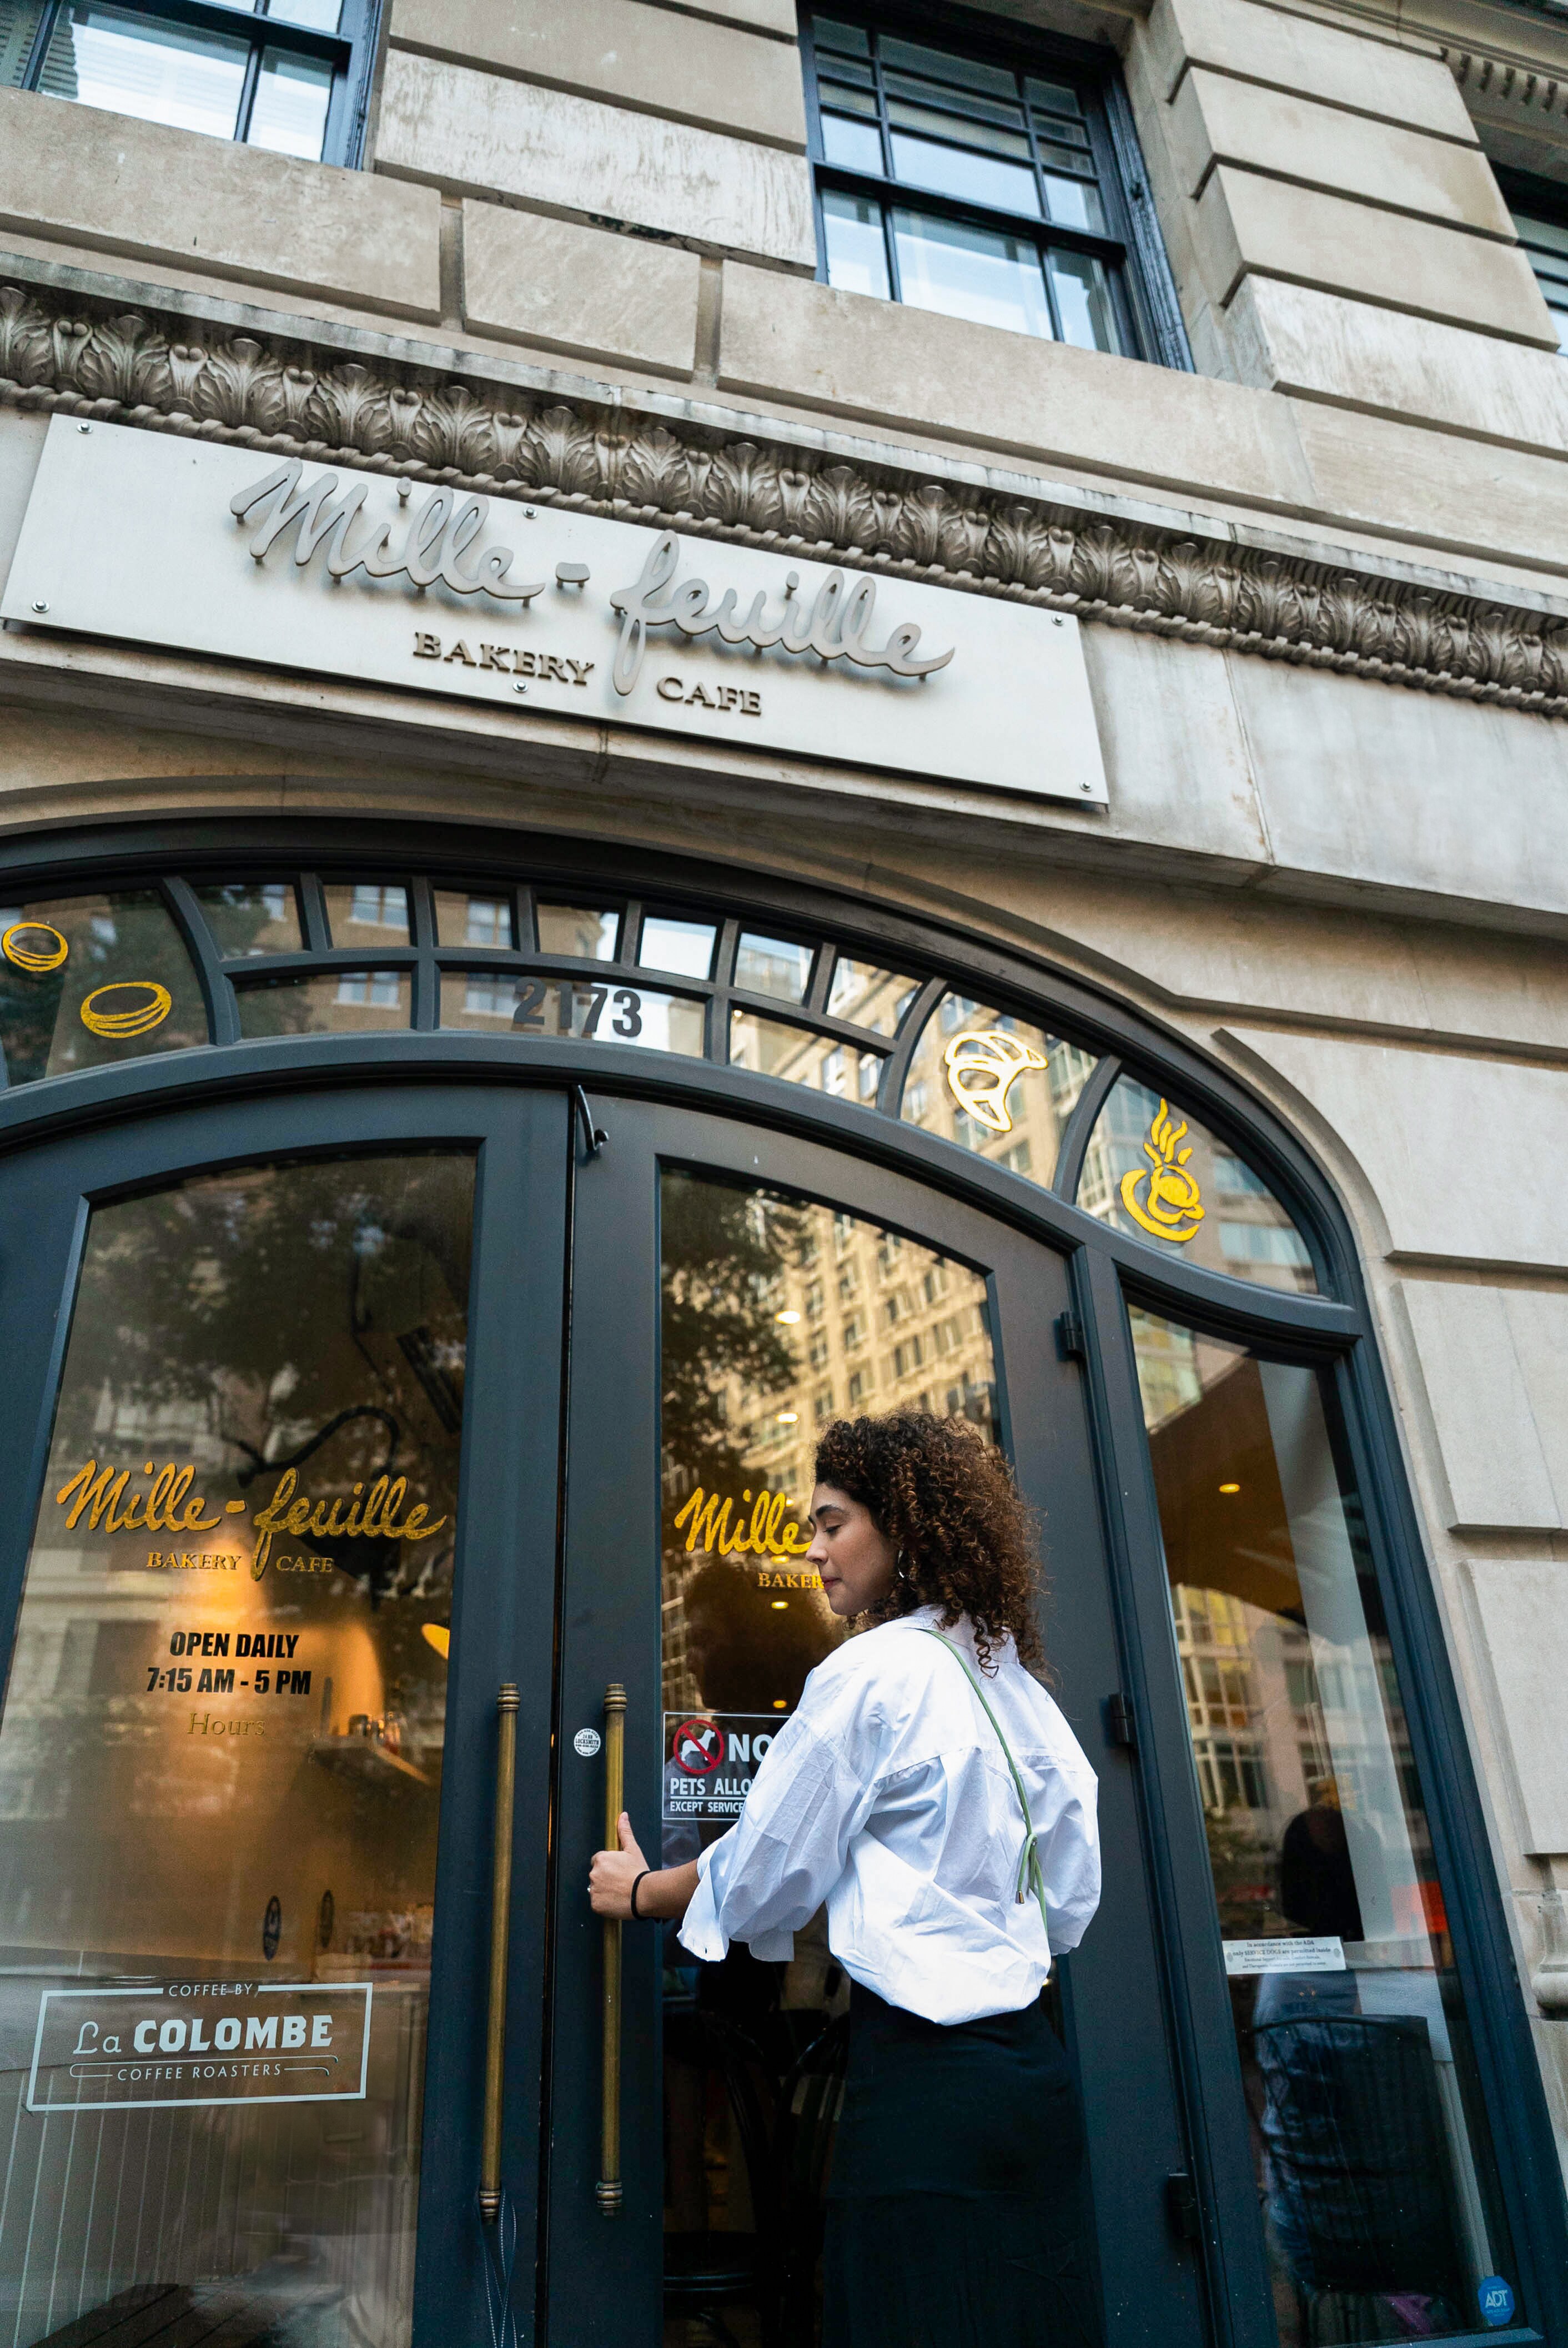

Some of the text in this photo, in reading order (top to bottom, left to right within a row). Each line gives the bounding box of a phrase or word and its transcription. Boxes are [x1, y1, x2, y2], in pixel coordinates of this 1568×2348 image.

[413, 632, 762, 716] BAKERY CAFE
[514, 976, 642, 1037] 2173
[147, 1552, 334, 1573] BAKERY CAFE
[757, 1572, 825, 1589] BAKER
[170, 1631, 299, 1659] OPEN DAILY
[147, 1667, 192, 1692] 7:15
[197, 1668, 235, 1693] AM
[255, 1670, 269, 1694] 5
[273, 1670, 312, 1695] PM
[187, 1712, 265, 1736] Hours
[728, 1733, 774, 1762] NO
[670, 1778, 754, 1795] PETS ALLO
[670, 1801, 743, 1813] EXCEPT SERVICE
[169, 1983, 253, 1997] COFFEE BY
[73, 2015, 333, 2054] La COLOMBE
[117, 2064, 281, 2081] COFFEE ROASTERS
[1485, 2289, 1507, 2309] ADT
